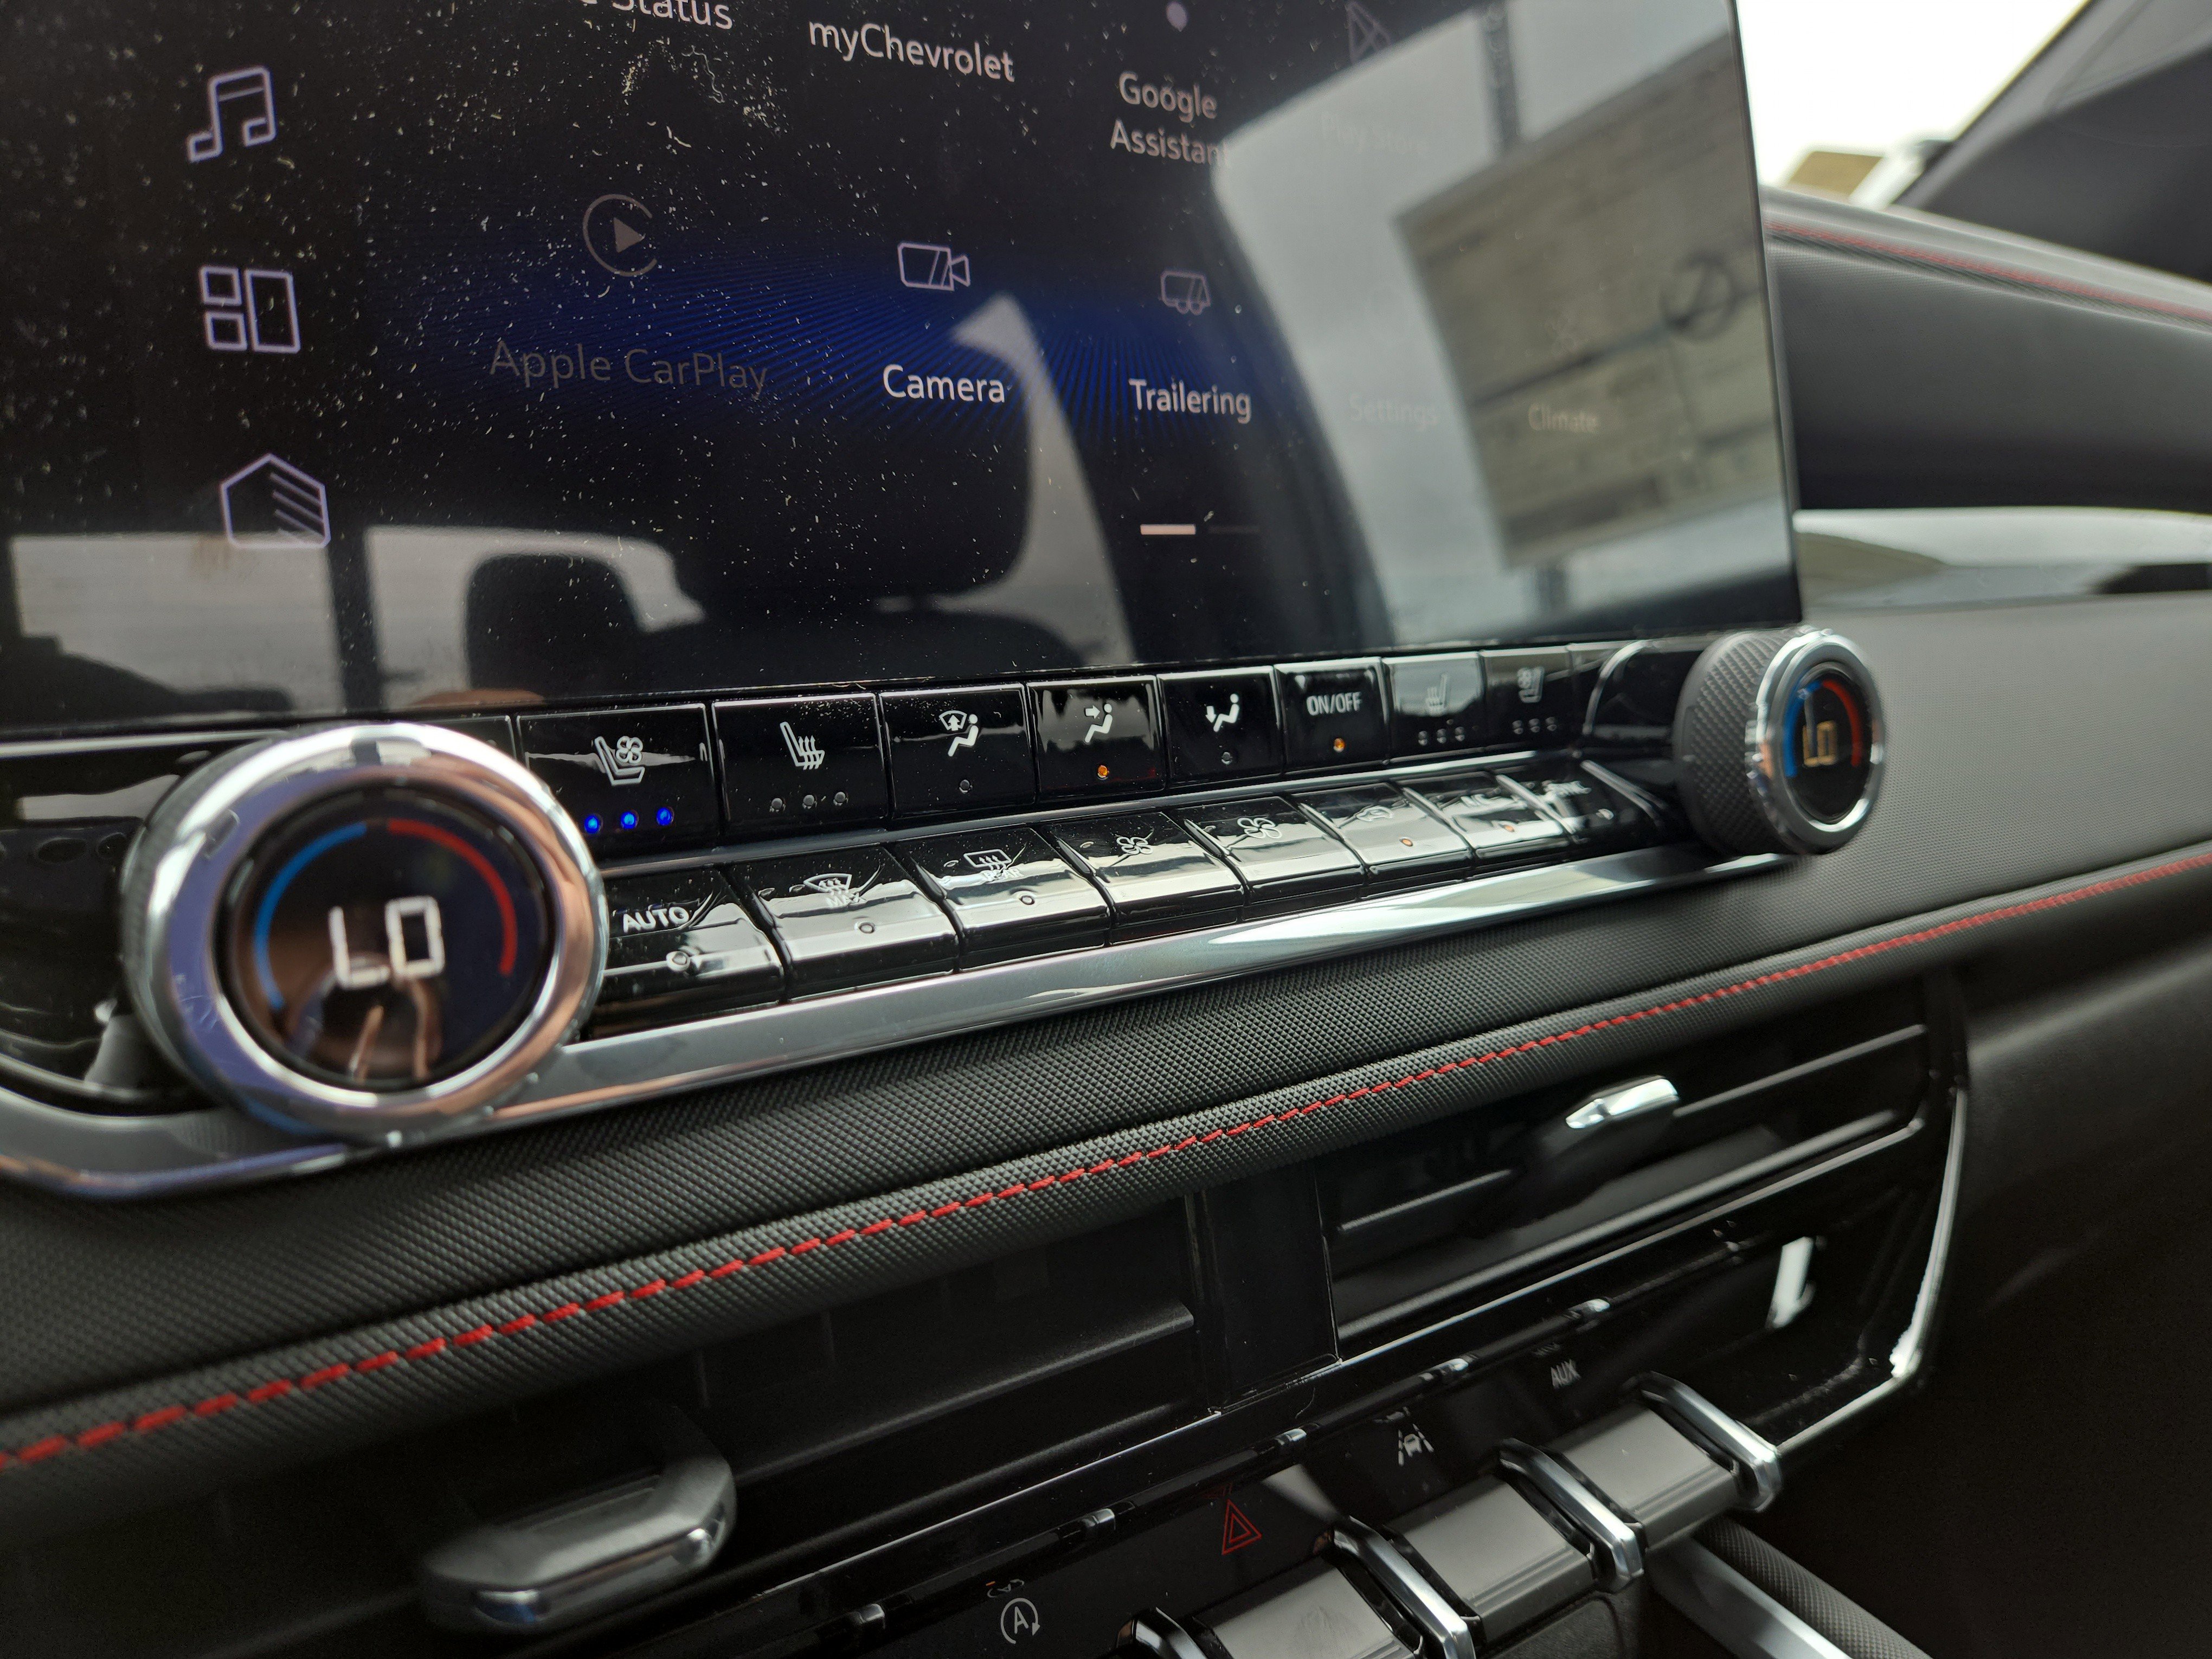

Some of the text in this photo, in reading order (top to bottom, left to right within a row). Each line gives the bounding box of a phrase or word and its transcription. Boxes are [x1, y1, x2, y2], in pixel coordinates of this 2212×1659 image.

[809, 21, 1015, 82] myChevrolet
[1119, 71, 1217, 123] Google
[490, 340, 768, 398] Apple CarPlay
[883, 364, 1005, 403] Camera
[1128, 378, 1252, 424] Trailering
[1528, 401, 1600, 434] Climate
[1306, 692, 1362, 716] ON/OFF
[623, 906, 690, 934] AUTO
[1551, 1359, 1581, 1388] AUX
